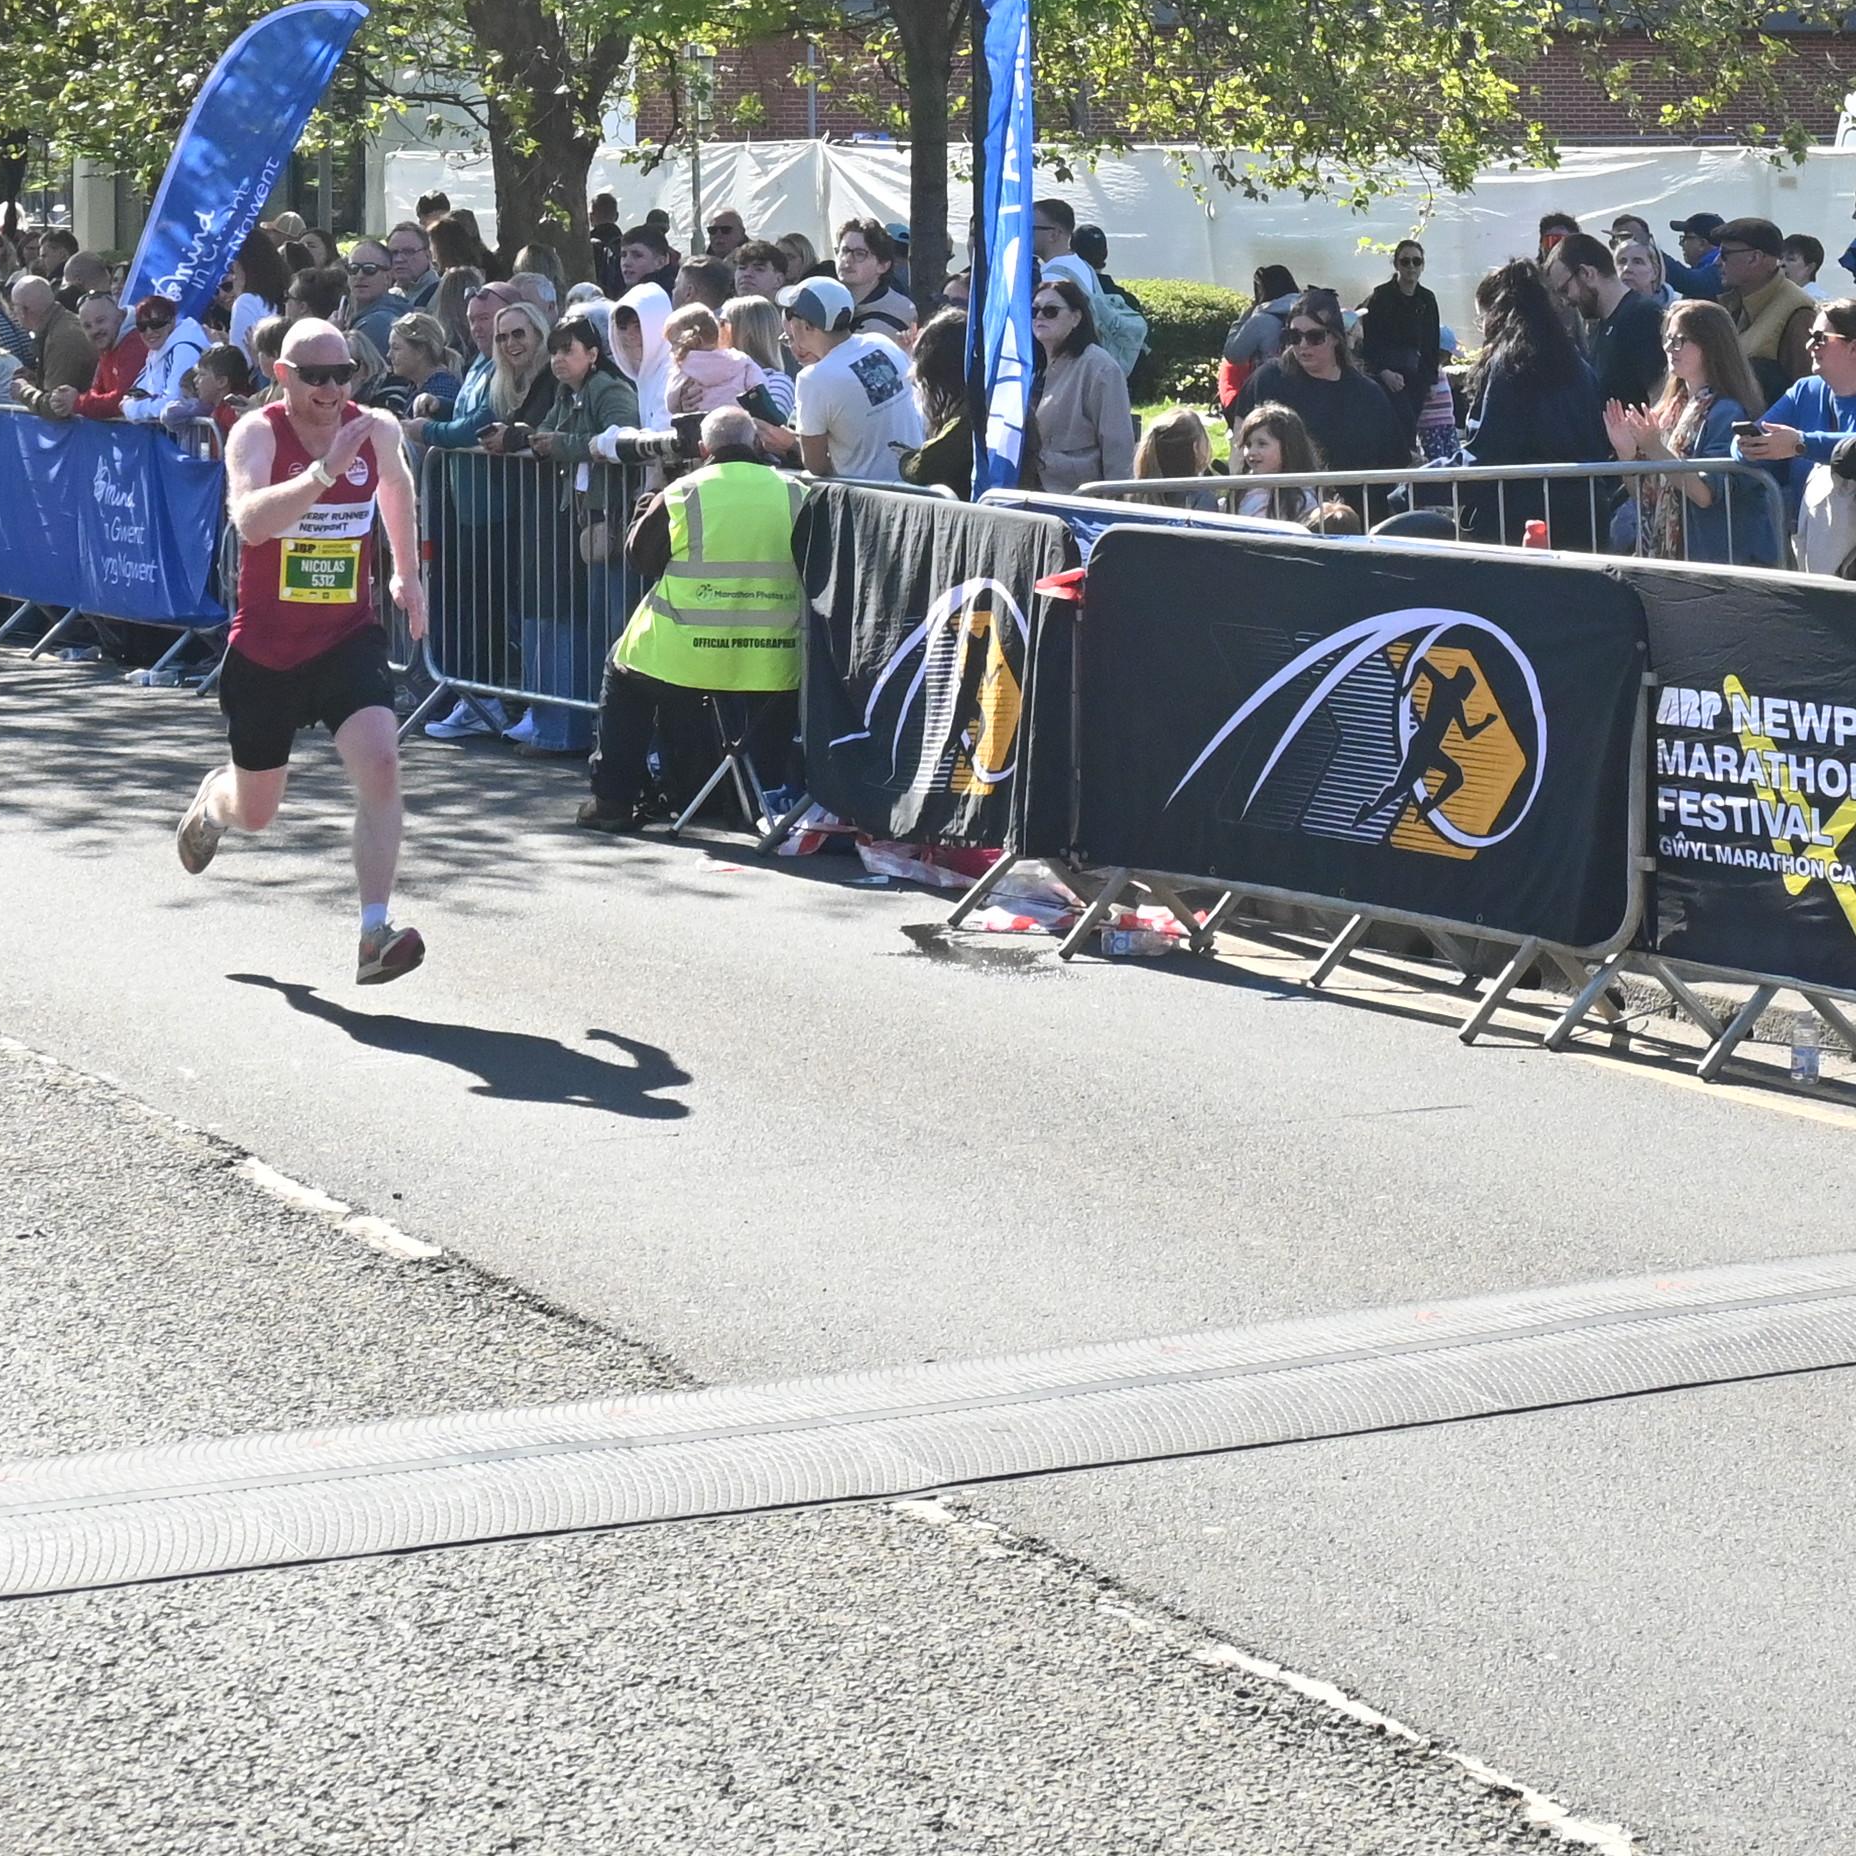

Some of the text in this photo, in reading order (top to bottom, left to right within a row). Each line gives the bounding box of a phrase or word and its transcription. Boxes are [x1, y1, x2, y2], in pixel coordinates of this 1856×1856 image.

[300, 559, 346, 573] NICOLAS
[311, 574, 336, 587] 5312
[692, 636, 730, 649] OFFICIAL
[1656, 686, 1723, 730] ABP
[1657, 786, 1835, 847] FESTIVAL
[1659, 831, 1713, 863] GŴYL
[1716, 843, 1825, 879] MARATHON
